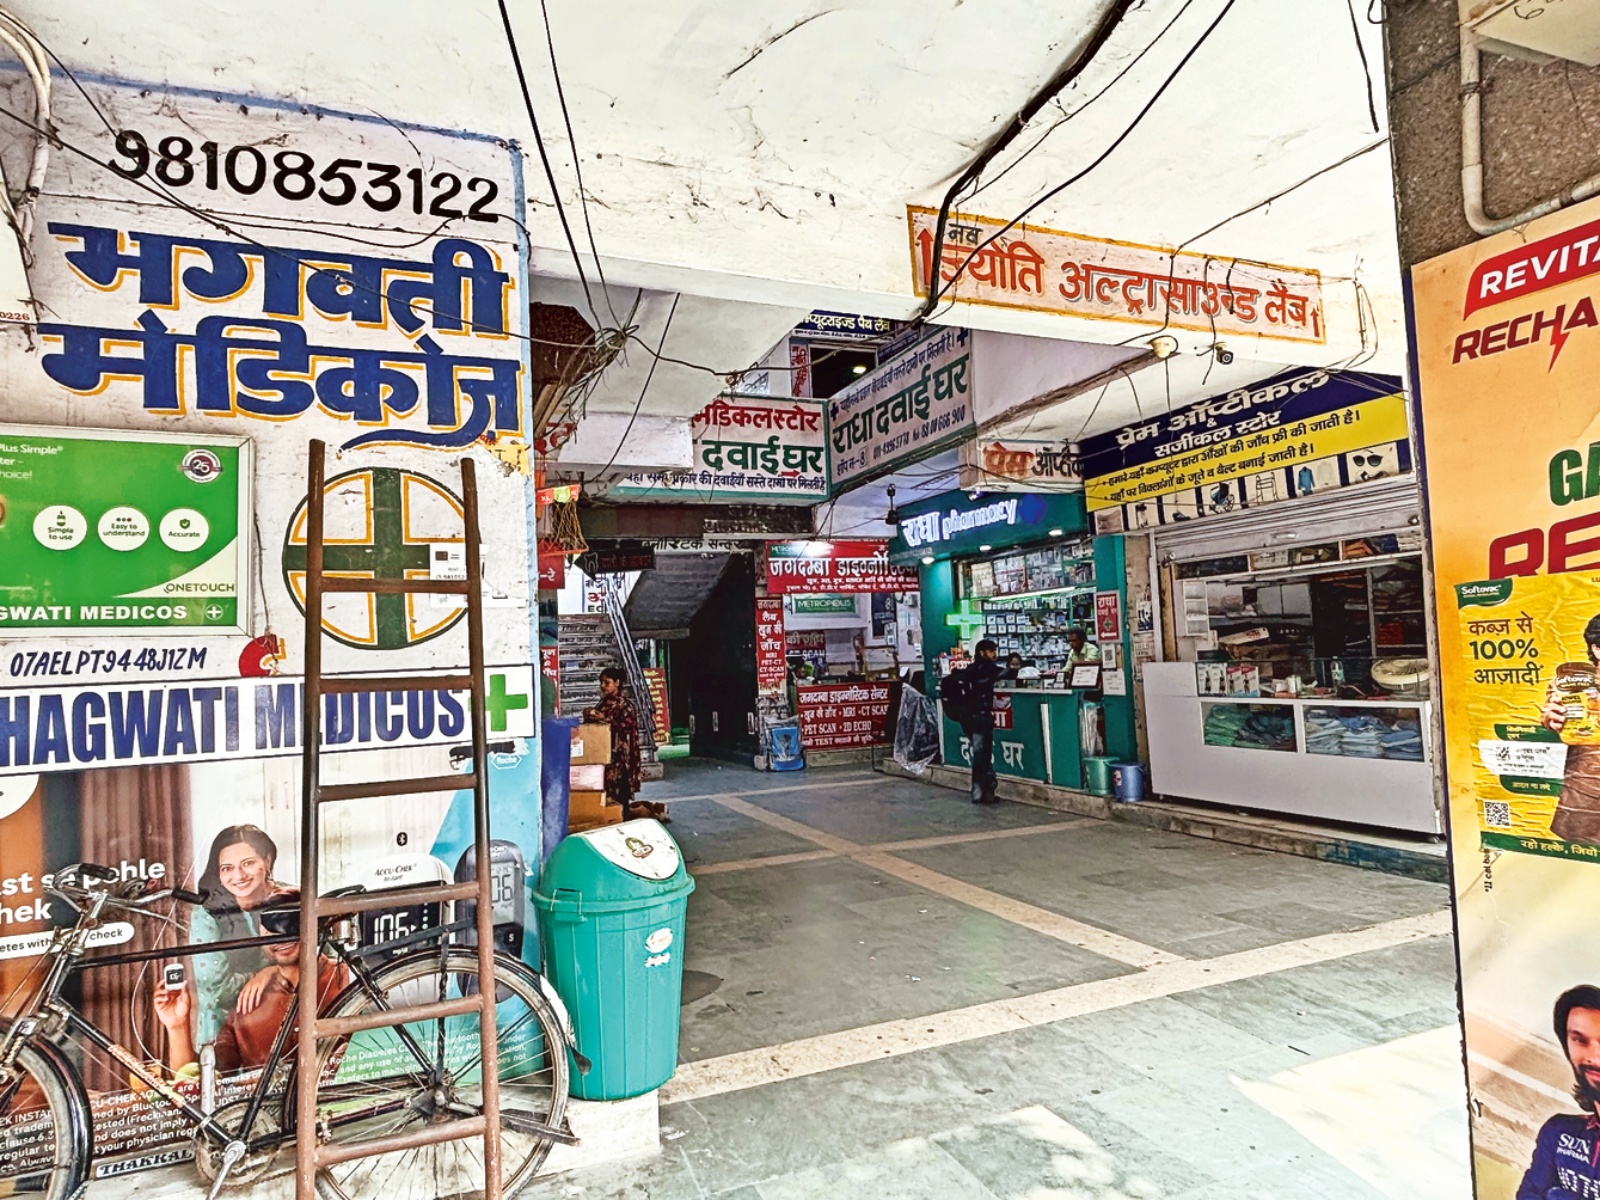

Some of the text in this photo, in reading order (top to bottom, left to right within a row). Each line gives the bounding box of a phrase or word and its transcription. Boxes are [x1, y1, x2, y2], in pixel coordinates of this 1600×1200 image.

[108, 129, 500, 223] 9810853122
[947, 222, 982, 244] नव
[48, 222, 516, 342] भगवती
[833, 407, 875, 454] राधा
[876, 363, 932, 435] दवाई
[932, 352, 970, 401] घर
[1235, 409, 1284, 437] स्टोर
[1290, 422, 1308, 440] की
[1310, 413, 1341, 435] जाती
[1115, 423, 1160, 452] प्रेम
[701, 436, 825, 475] दवाई घर
[942, 498, 1018, 540] pharmacy
[79, 605, 188, 620] MEDICOS
[797, 599, 852, 609] METROPOLIS
[1515, 610, 1534, 634] से
[1468, 638, 1539, 661] 100%
[818, 723, 838, 734] SCAN
[89, 928, 124, 942] check
[111, 1126, 138, 1140] does
[139, 1122, 158, 1134] not
[126, 1132, 176, 1150] physician
[1558, 1133, 1590, 1155] SUN
